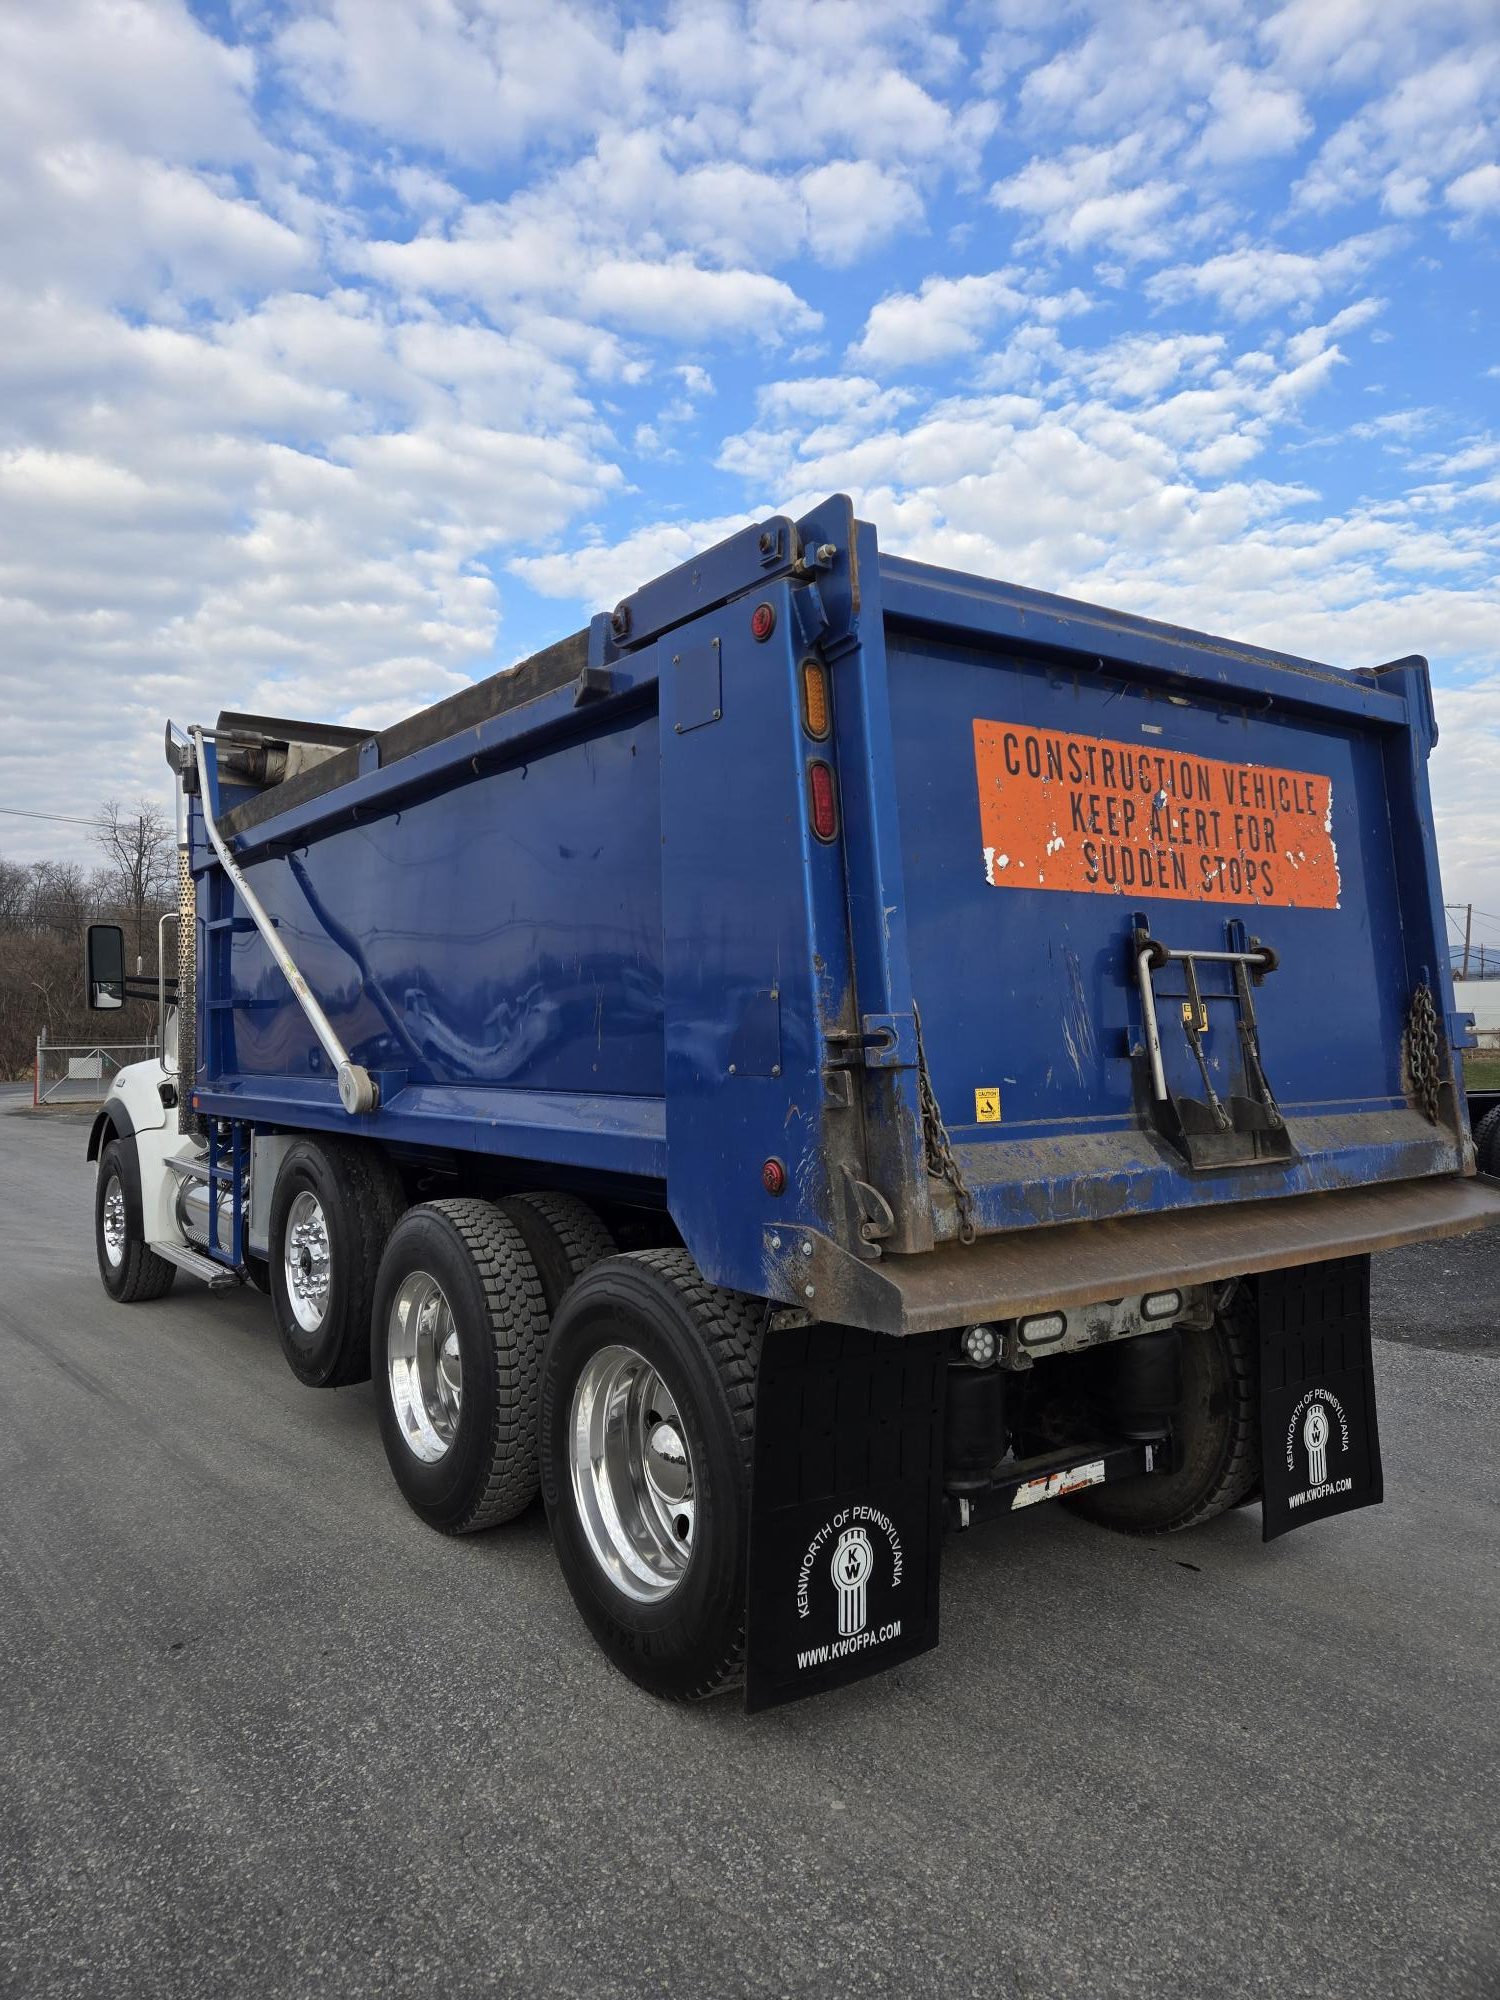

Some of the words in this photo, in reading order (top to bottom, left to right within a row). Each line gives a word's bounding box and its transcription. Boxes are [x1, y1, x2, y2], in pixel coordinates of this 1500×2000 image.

[1002, 732, 1212, 802] CONSTRUCTION
[1222, 768, 1318, 816] VEHICLE
[1070, 791, 1136, 839] KEEP
[1150, 802, 1221, 849] ALERT
[1235, 814, 1278, 853] FOR
[1083, 841, 1187, 890] SUDDEN
[1200, 854, 1275, 897] STOPS
[1286, 1400, 1305, 1471] KENWORTH
[1303, 1391, 1314, 1404] OF
[1314, 1388, 1349, 1452] PENNSYLVANIA
[1288, 1477, 1352, 1509] WWW.KWOFPA.COM
[797, 1523, 833, 1619] KENWORTH
[833, 1508, 851, 1528] OF
[853, 1506, 903, 1587] PENNSYLVANIA
[797, 1620, 901, 1669] WWW.KWOFPA.COM
